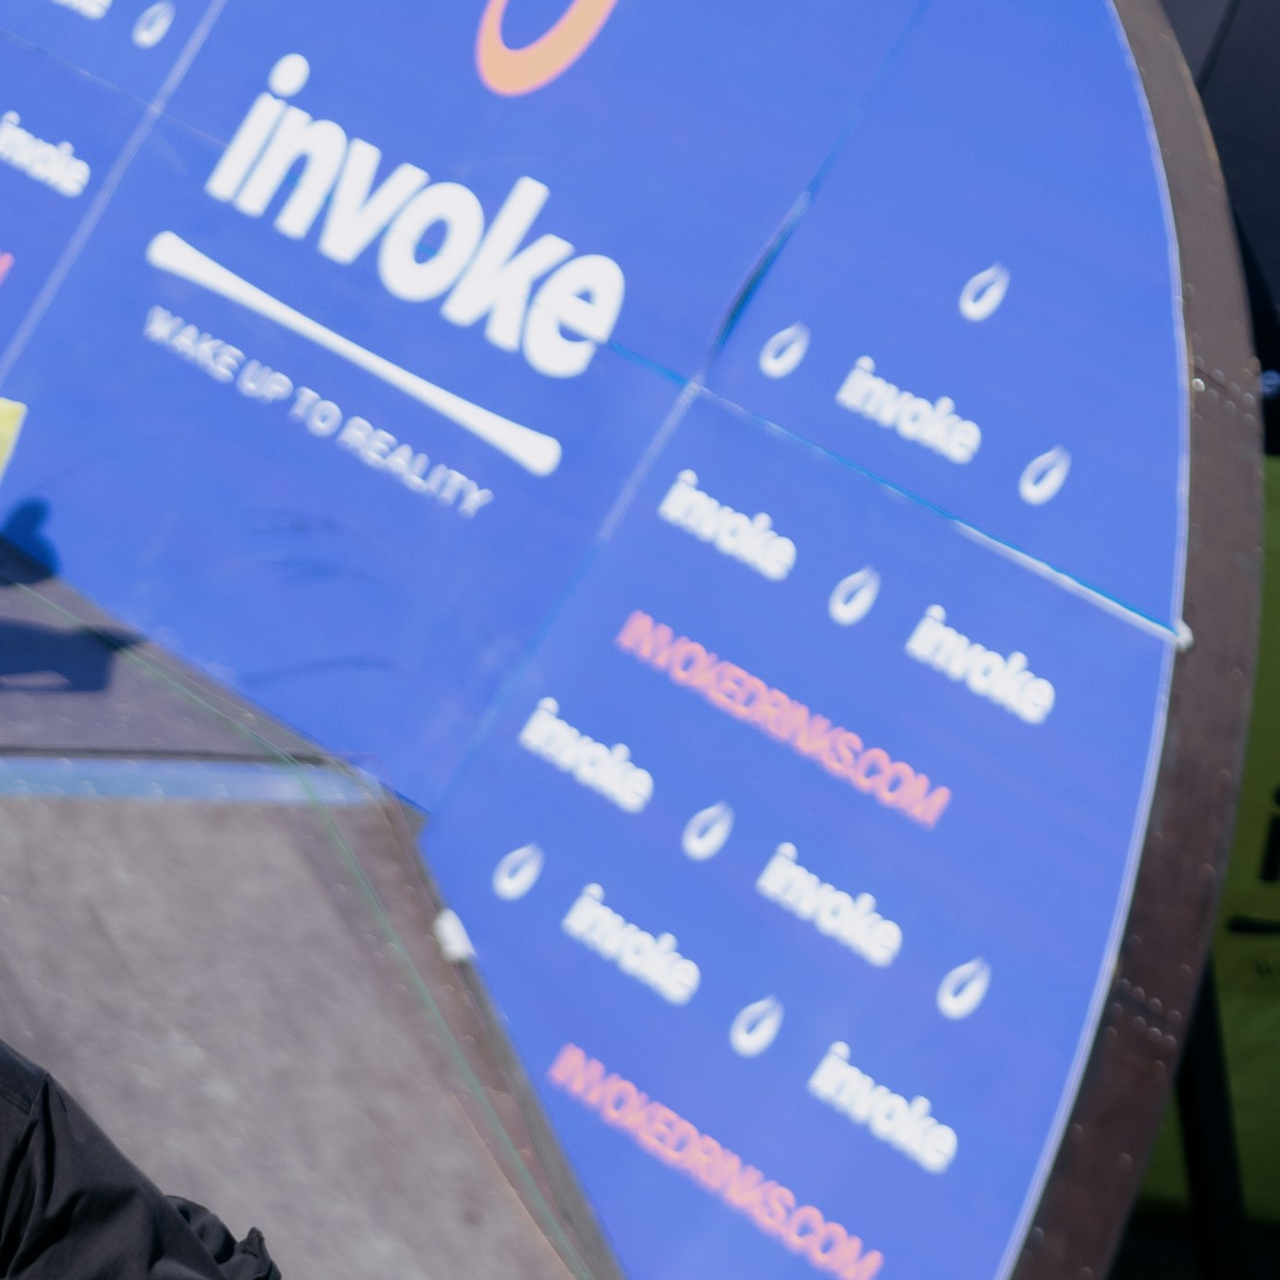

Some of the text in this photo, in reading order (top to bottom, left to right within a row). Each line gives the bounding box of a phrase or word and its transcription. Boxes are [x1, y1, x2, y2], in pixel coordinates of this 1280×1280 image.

[204, 53, 625, 377] invoke
[144, 304, 495, 519] WAKE UP TO REALITY
[836, 355, 982, 464] invoke
[658, 468, 797, 581] invoke
[615, 609, 952, 829] INVOKEDRINKS.COM
[905, 603, 1056, 724] invoke
[519, 696, 654, 813] invoke
[562, 882, 701, 1005] invoke
[756, 841, 903, 968] invoke
[808, 1040, 958, 1174] invoke
